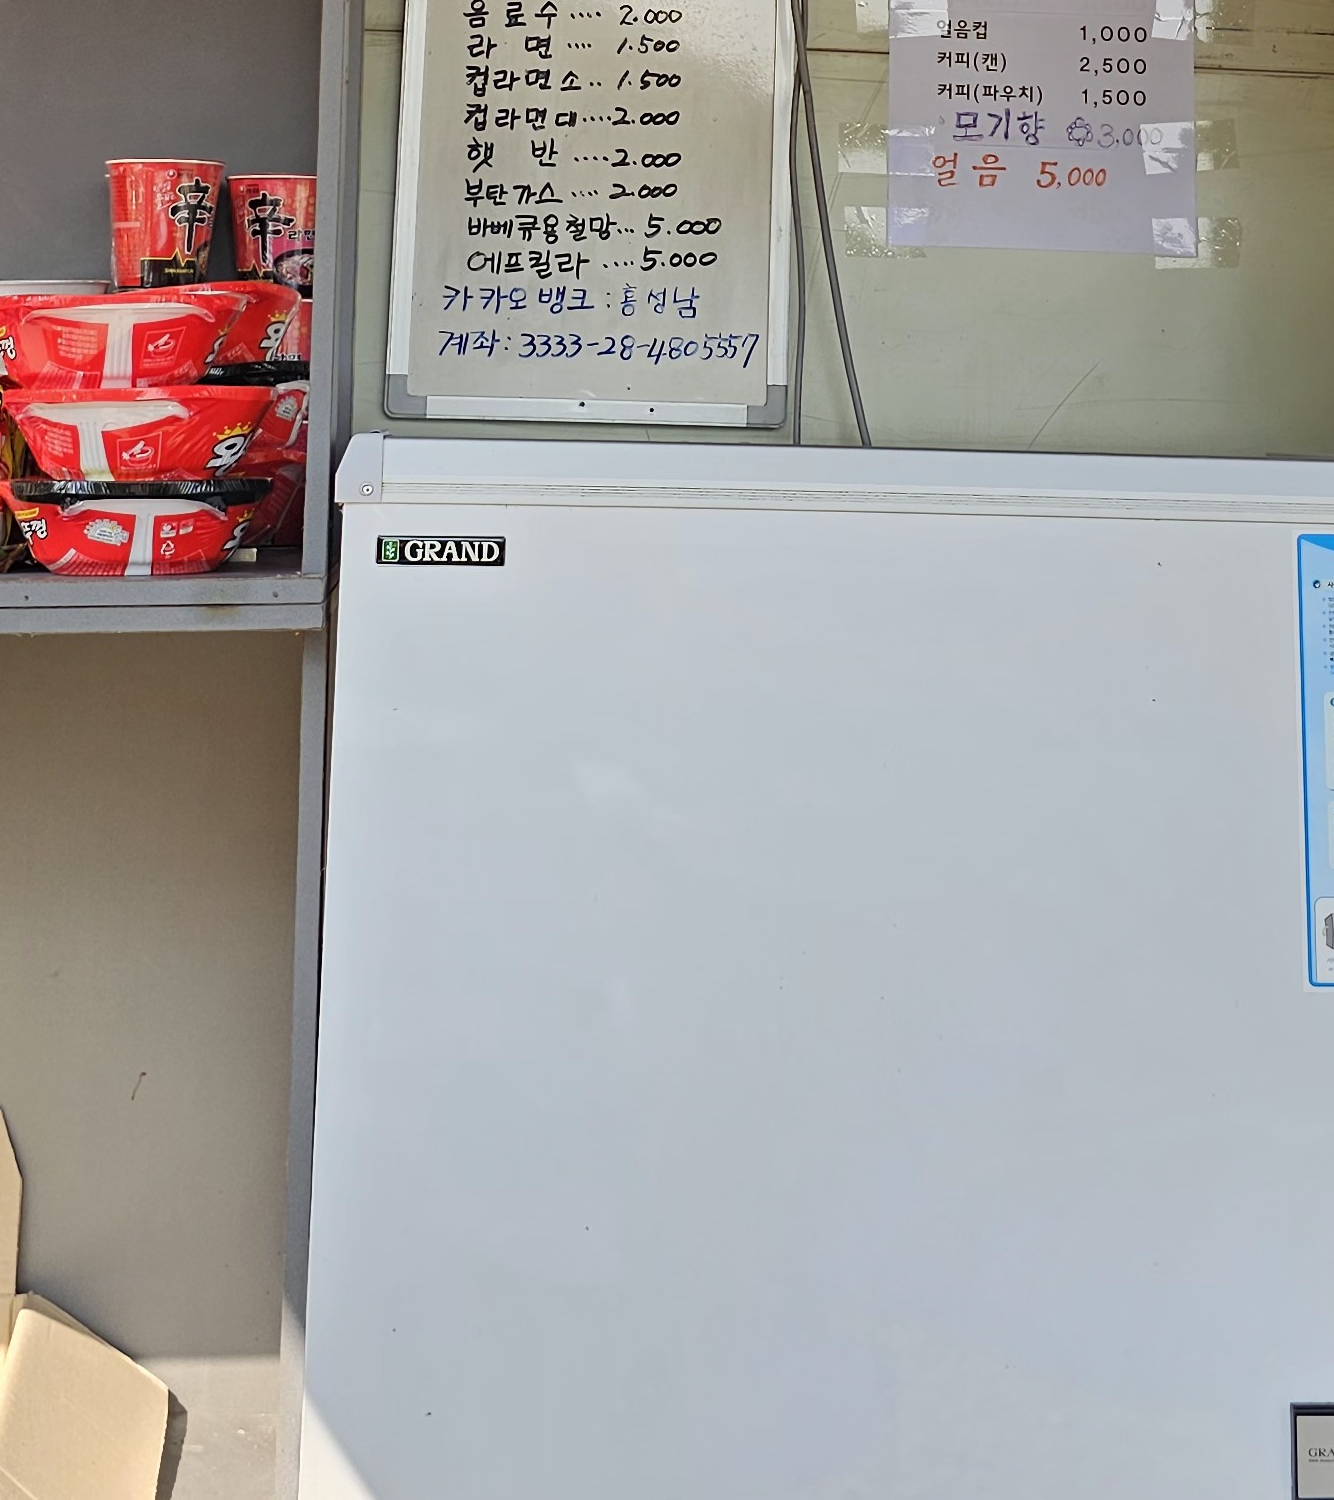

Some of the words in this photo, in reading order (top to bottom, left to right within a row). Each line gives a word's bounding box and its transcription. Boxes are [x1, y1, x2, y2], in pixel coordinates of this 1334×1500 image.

[1080, 25, 1147, 44] 1,000
[937, 52, 1008, 74] 커피(캔)
[1079, 56, 1147, 76] 2,500
[937, 83, 1044, 104] 커피(파우치)
[1080, 88, 1147, 108] 1,500
[952, 108, 1046, 147] 모기향
[404, 540, 500, 562] GRAND
